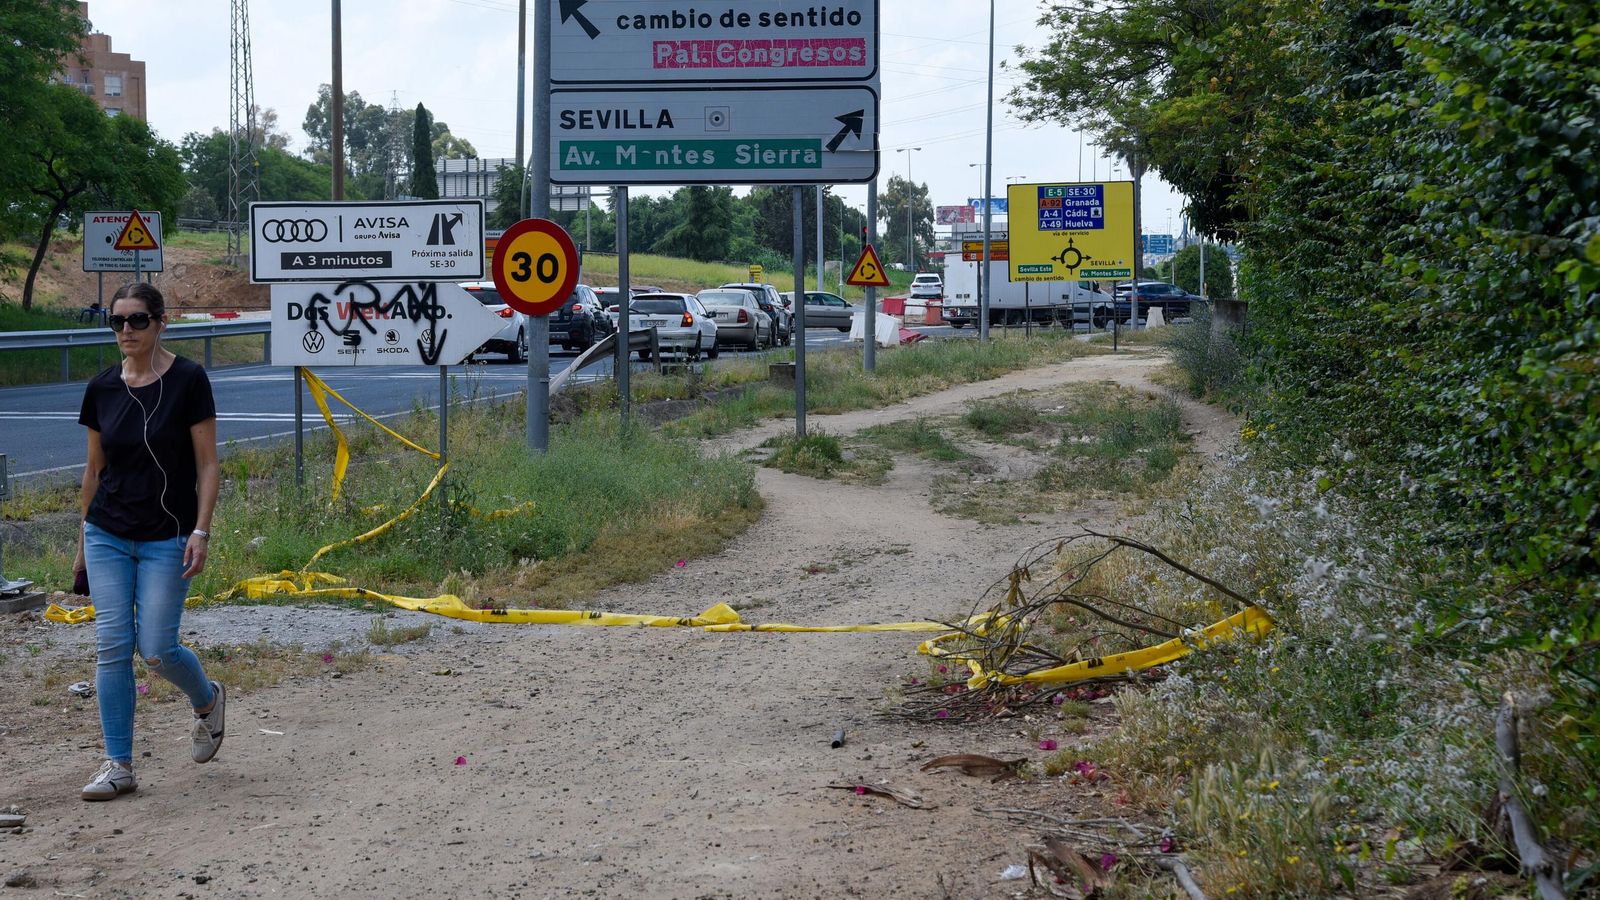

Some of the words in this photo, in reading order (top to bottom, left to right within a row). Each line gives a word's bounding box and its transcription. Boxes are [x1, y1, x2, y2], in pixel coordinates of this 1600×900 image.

[616, 8, 713, 30] cambio
[719, 8, 751, 29] de
[758, 6, 862, 28] sentido
[656, 42, 708, 65] Pal.
[715, 41, 864, 67] Congresos
[559, 108, 675, 130] SEVILLA
[564, 145, 600, 166] Av.
[615, 144, 715, 165] Mntes
[734, 143, 818, 165] Sierra
[1048, 188, 1063, 196] E-5
[1068, 187, 1095, 196] SE-30
[1041, 199, 1061, 207] A-92
[1065, 198, 1100, 207] Granada
[1043, 210, 1059, 218] A-4
[1065, 209, 1088, 217] Cádiz
[92, 216, 151, 224] ATENCN
[354, 216, 410, 229] AVISA
[1041, 220, 1062, 228] A-49
[1065, 220, 1094, 228] Huelva
[378, 230, 401, 239] Avisa
[411, 249, 447, 258] Próxima
[448, 249, 473, 257] salida
[292, 255, 304, 266] A
[308, 255, 317, 266] 3
[321, 255, 384, 266] minutos
[429, 260, 456, 268] SE-30
[511, 251, 559, 284] 30
